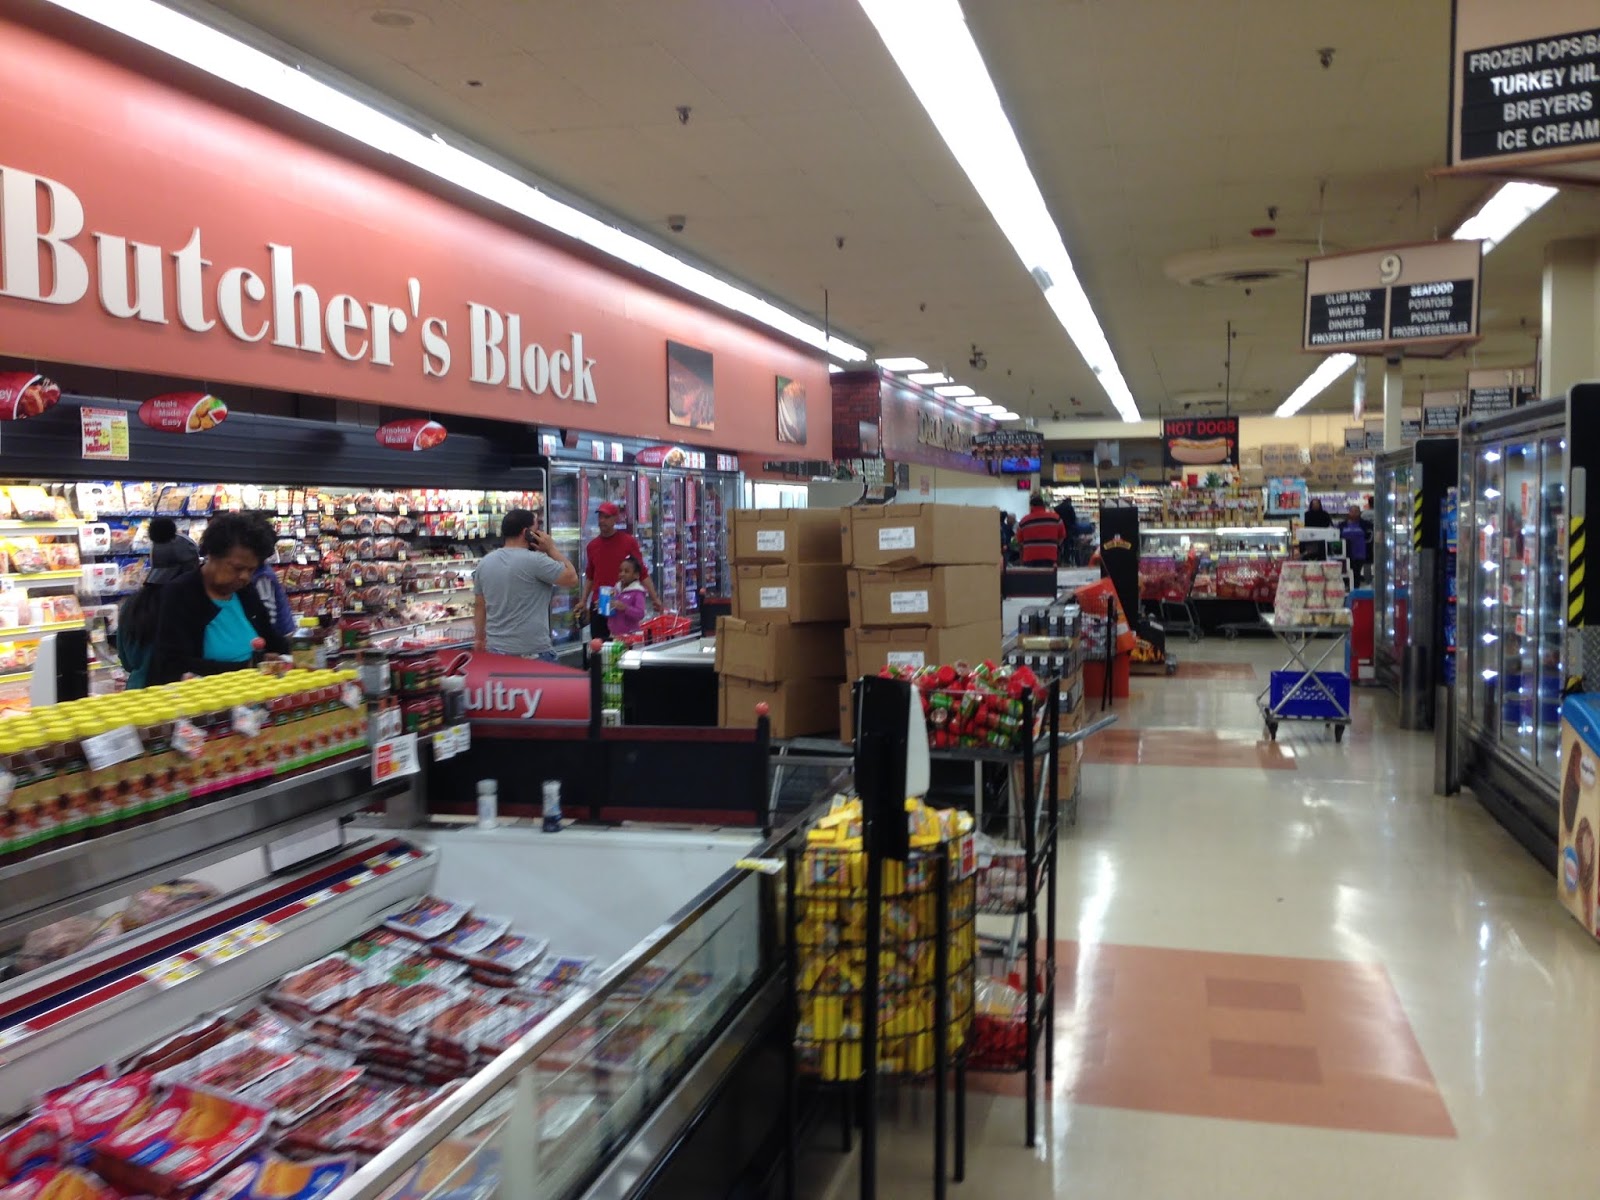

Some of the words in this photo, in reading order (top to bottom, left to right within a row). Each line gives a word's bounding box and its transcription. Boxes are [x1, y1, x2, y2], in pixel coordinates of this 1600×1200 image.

[1469, 45, 1534, 74] FROZEN
[1490, 66, 1567, 97] TURKEY
[1503, 90, 1594, 123] BREYERS
[1496, 127, 1528, 151] ICE
[1531, 117, 1600, 146] CREAM
[1379, 254, 1403, 284] 9
[0, 164, 451, 379] Butcher's
[466, 301, 598, 404] Block
[1410, 281, 1454, 298] SEAFOOD
[1325, 294, 1348, 306] CLUB
[1349, 291, 1372, 304] PACK
[1408, 296, 1454, 310] POTATOES
[1328, 304, 1367, 318] WAFFLES
[1410, 310, 1451, 324] POULTRY
[1328, 317, 1365, 331] DINNERS
[1392, 324, 1421, 338] FROZEN
[1421, 321, 1469, 335] VEGETABLES
[1312, 331, 1344, 345] FROZEN
[1345, 328, 1383, 342] ENTREES
[161, 418, 182, 428] Easy
[381, 426, 411, 435] Smoked
[1166, 421, 1194, 436] HOT
[1196, 420, 1236, 436] DOGS
[464, 680, 543, 719] ultry
